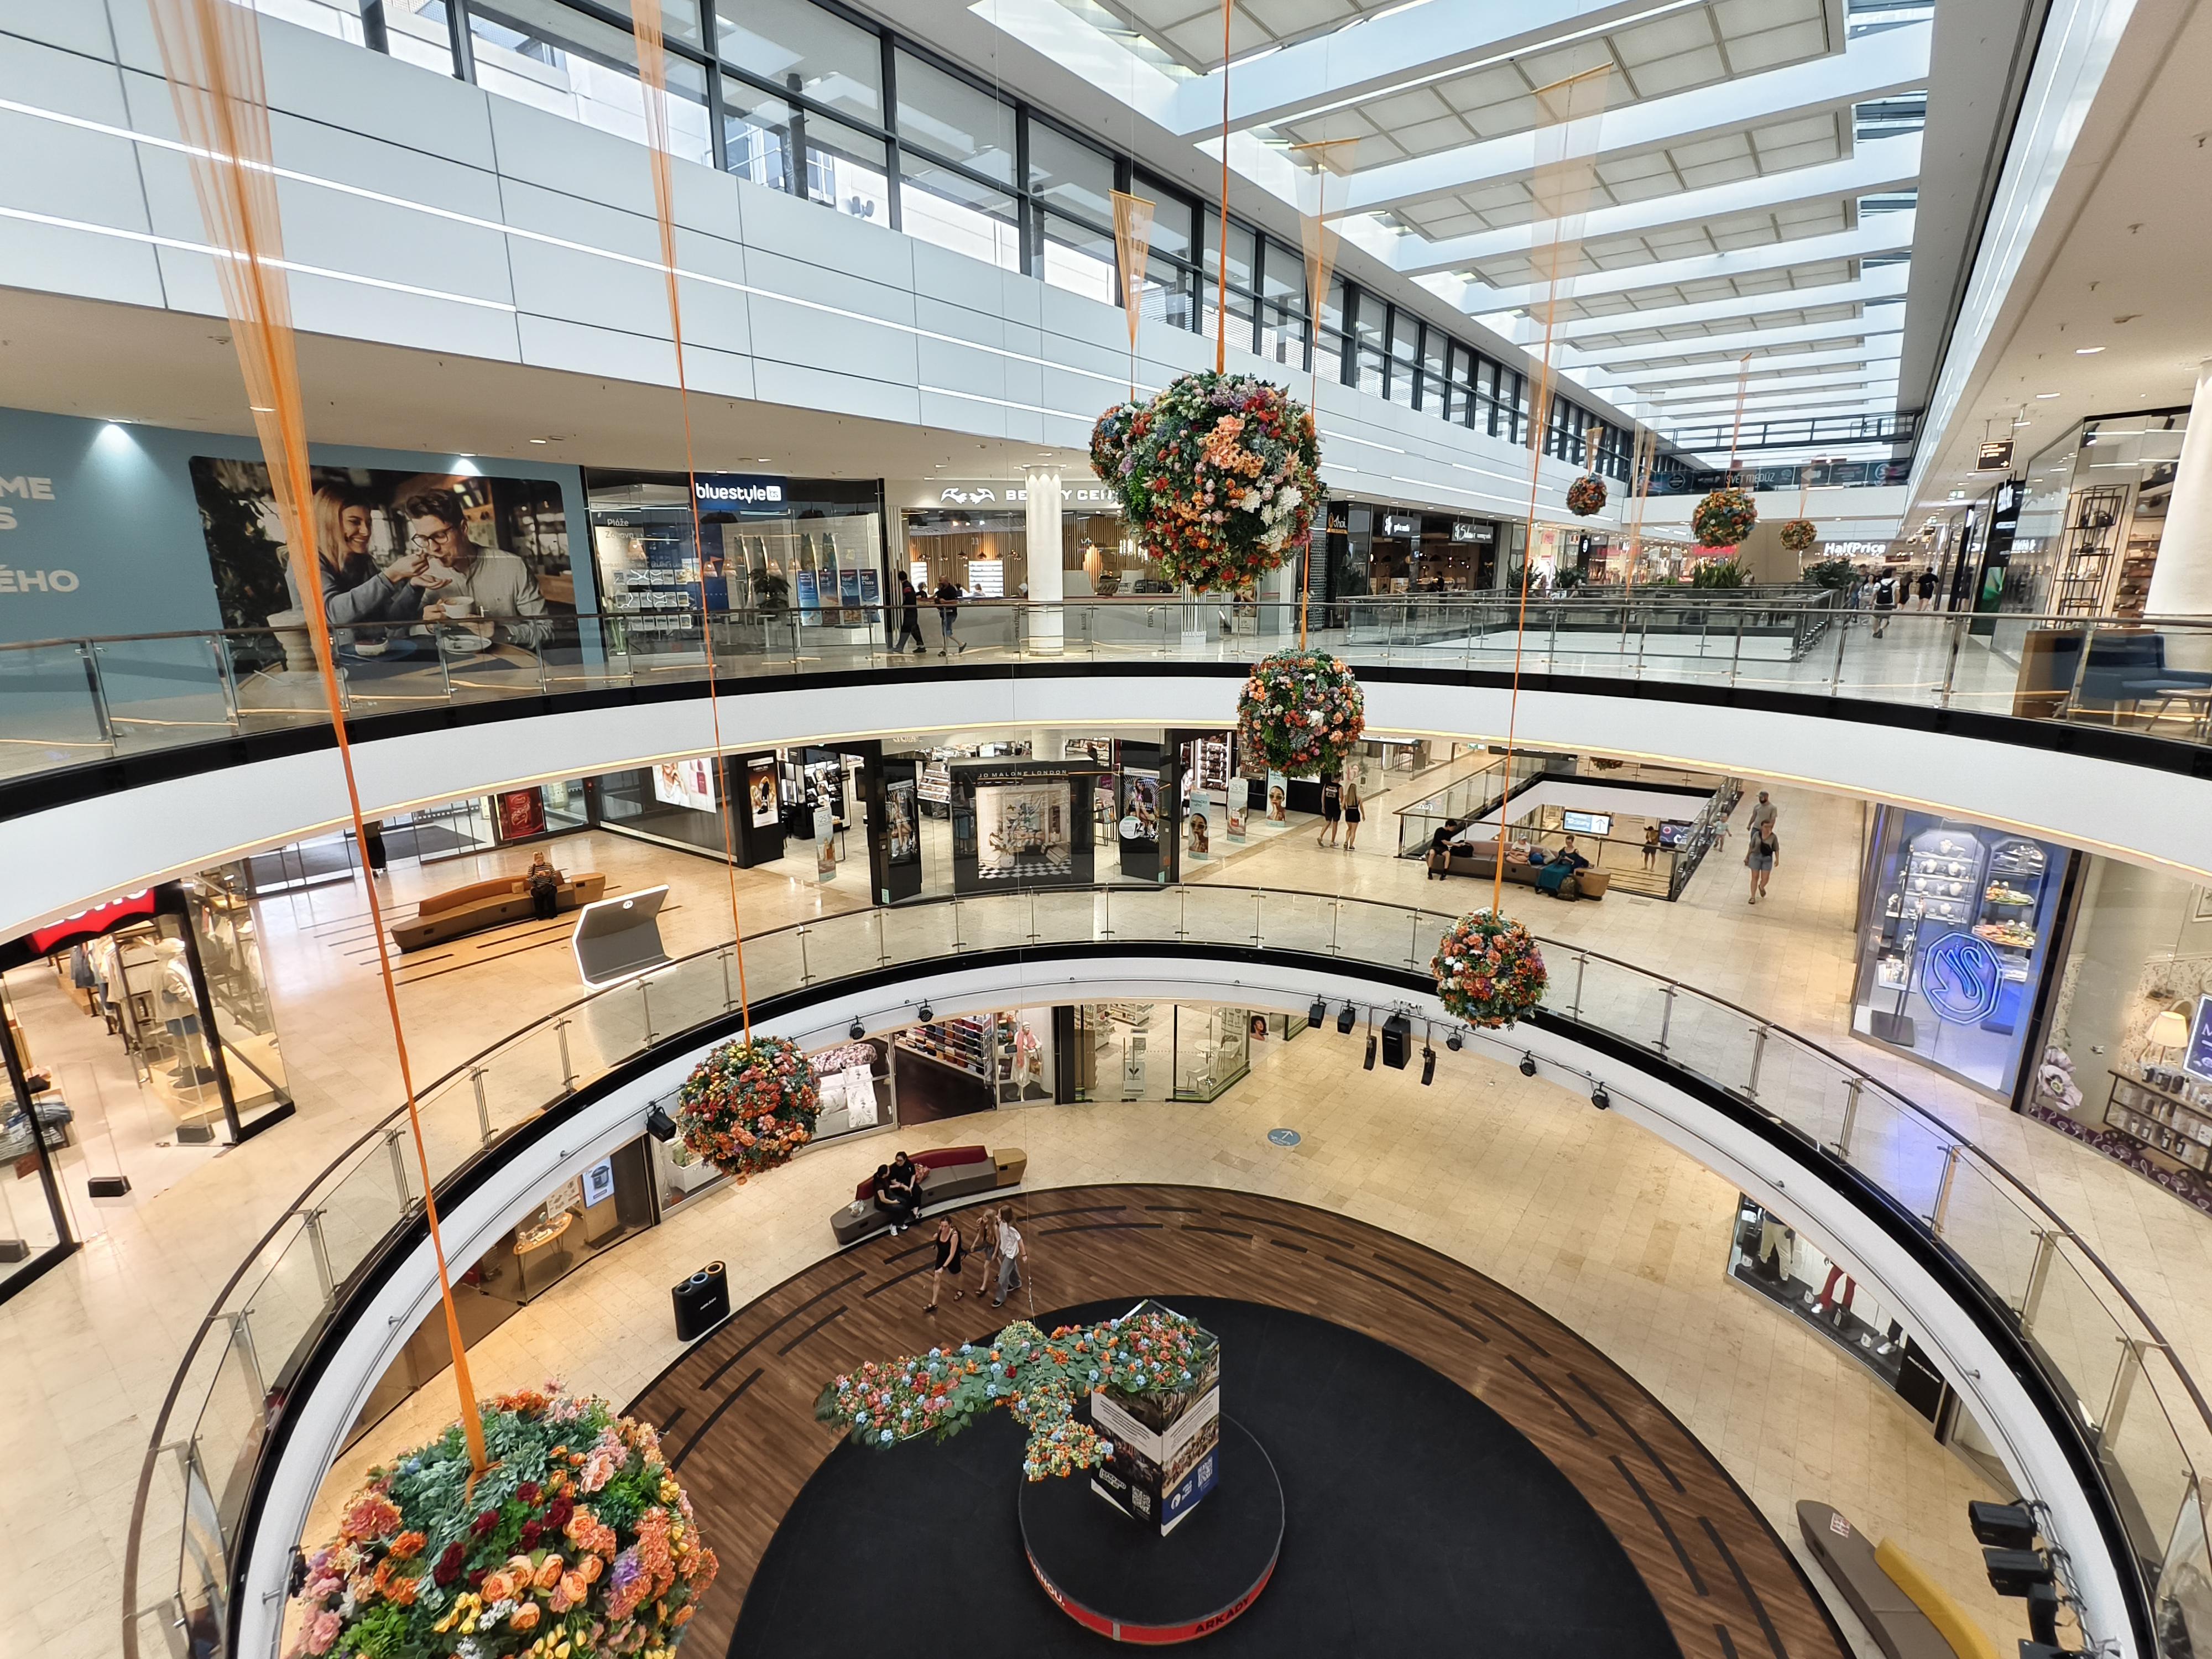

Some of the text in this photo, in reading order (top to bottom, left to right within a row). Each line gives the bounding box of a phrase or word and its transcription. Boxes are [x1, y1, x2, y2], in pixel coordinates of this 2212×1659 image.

[695, 482, 766, 504] bluestyle
[1005, 489, 1073, 500] BEY
[607, 518, 629, 526] Pláže
[1824, 542, 1886, 555] HalfPrice
[1196, 1595, 1250, 1634] ARKADY
